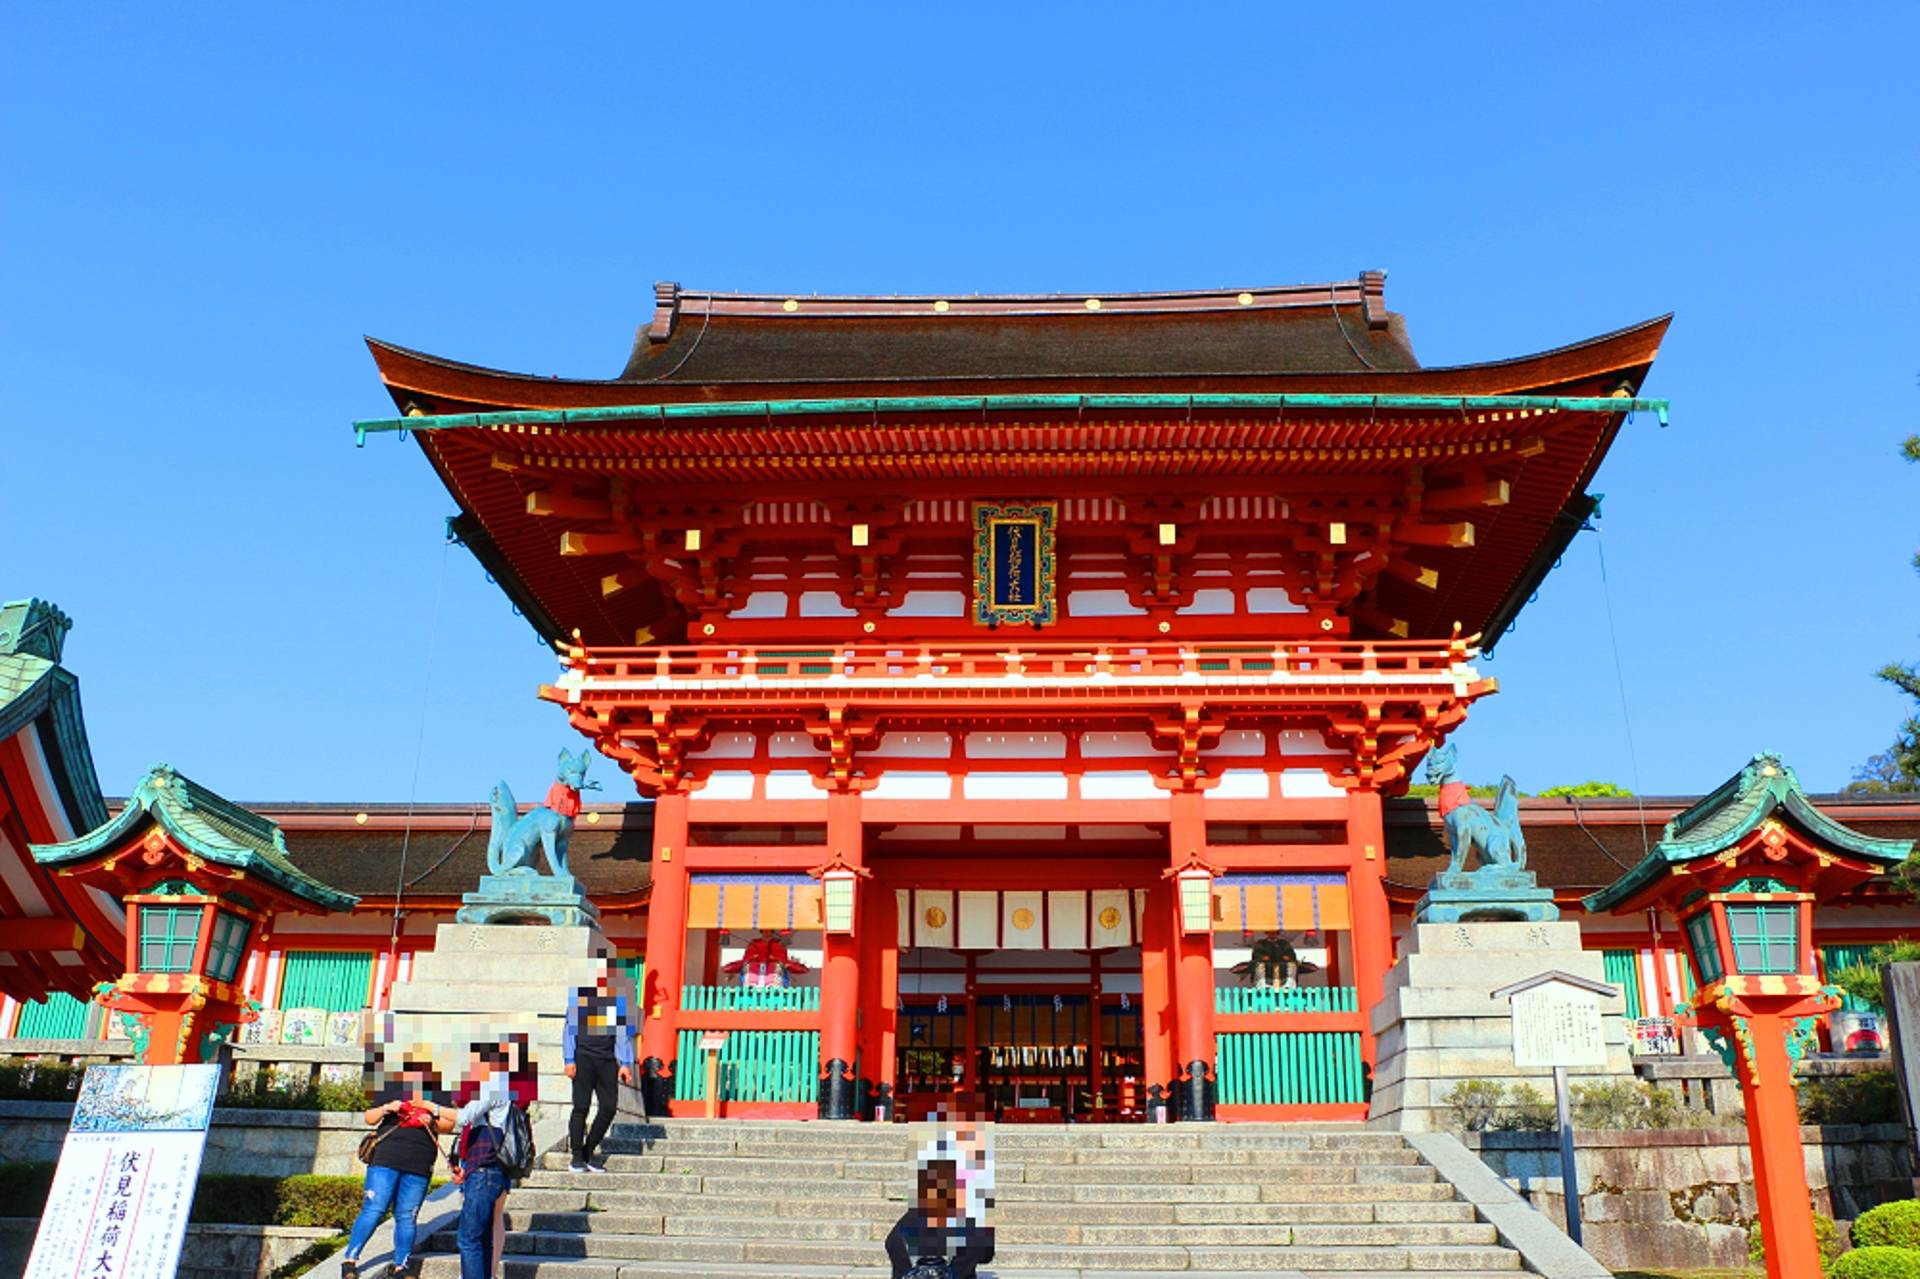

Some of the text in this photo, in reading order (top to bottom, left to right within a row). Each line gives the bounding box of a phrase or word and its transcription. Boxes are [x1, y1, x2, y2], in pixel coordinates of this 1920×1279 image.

[92, 1150, 141, 1279] 伏見稲荷大
